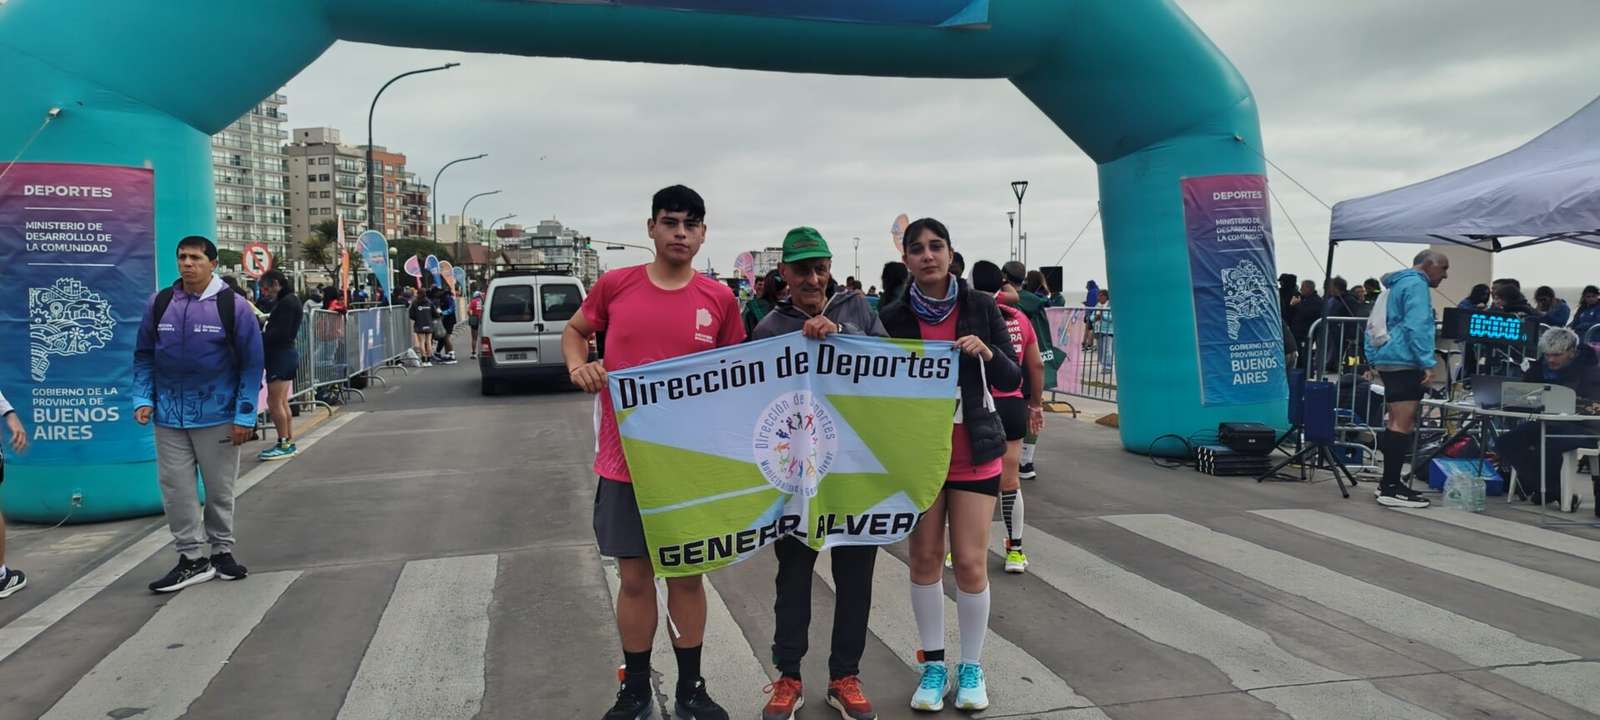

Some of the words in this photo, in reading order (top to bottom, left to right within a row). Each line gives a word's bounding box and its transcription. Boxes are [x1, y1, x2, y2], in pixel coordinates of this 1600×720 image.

[24, 185, 113, 198] DEPORTES
[1213, 191, 1263, 200] DEPORTES
[25, 221, 85, 231] MINISTERIO
[87, 222, 104, 231] DE
[25, 232, 95, 242] DESARROLLO
[96, 233, 113, 242] DE
[26, 243, 39, 252] LA
[41, 243, 108, 253] COMUNIDAD
[1231, 356, 1278, 372] BUENOS
[618, 358, 767, 411] Dirección
[775, 345, 810, 379] de
[815, 343, 952, 384] Deportes
[1232, 371, 1269, 385] AIRES
[32, 387, 84, 397] GOBIERNO
[86, 387, 102, 396] DE
[103, 386, 118, 396] LA
[32, 398, 87, 407] PROVINCIA
[88, 397, 105, 406] DE
[33, 406, 120, 423] BUENOS
[33, 424, 94, 441] AIRES
